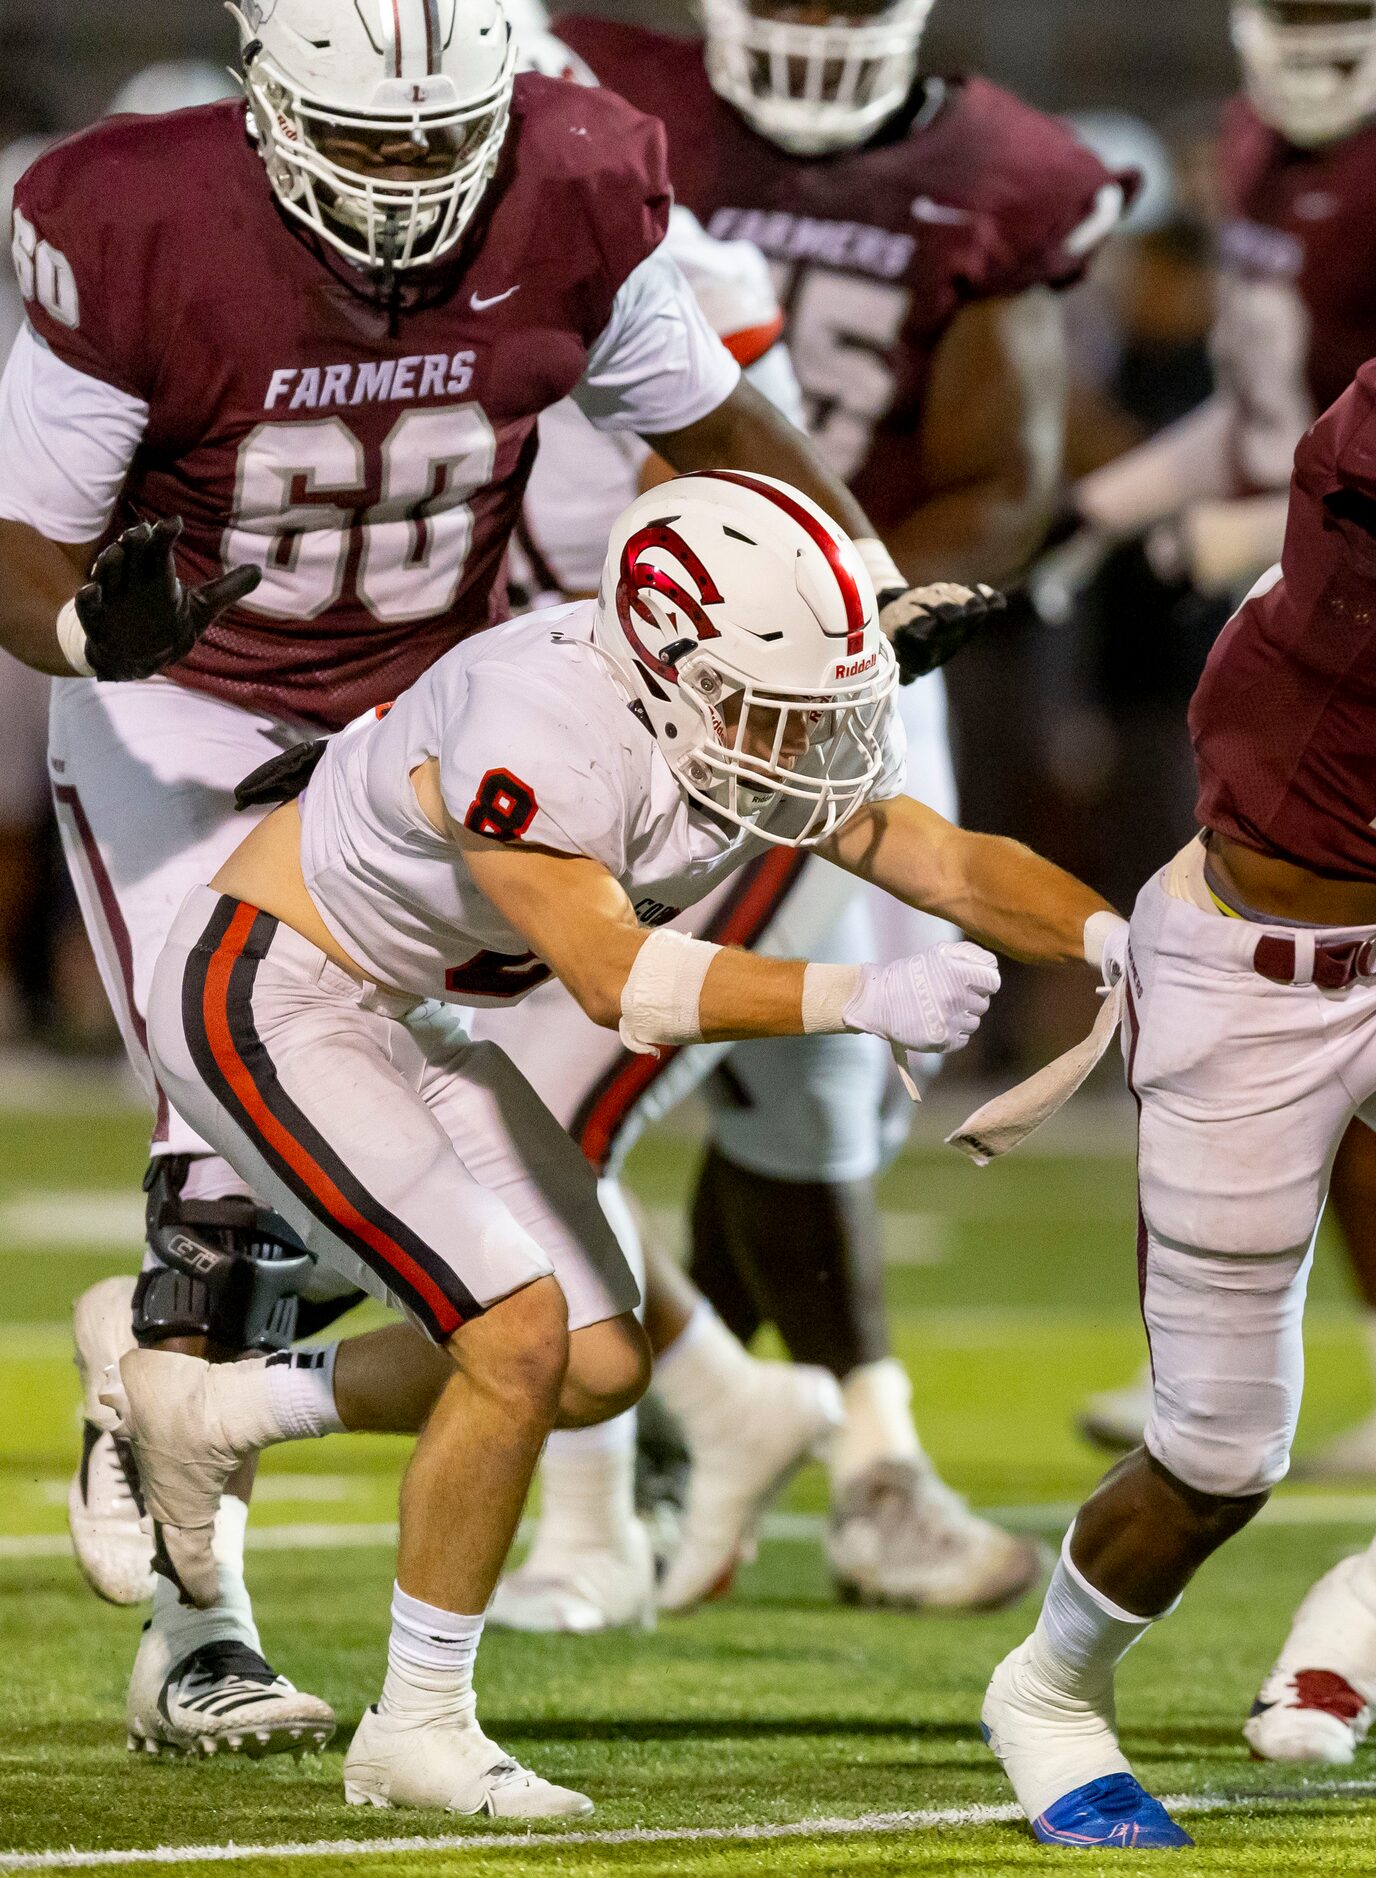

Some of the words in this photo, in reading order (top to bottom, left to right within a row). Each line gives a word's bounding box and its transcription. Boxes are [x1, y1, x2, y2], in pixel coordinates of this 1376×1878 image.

[11, 207, 80, 330] 60
[263, 350, 477, 410] FARMERS
[220, 400, 497, 622] 60
[835, 654, 877, 681] Riddell
[463, 767, 540, 842] 8
